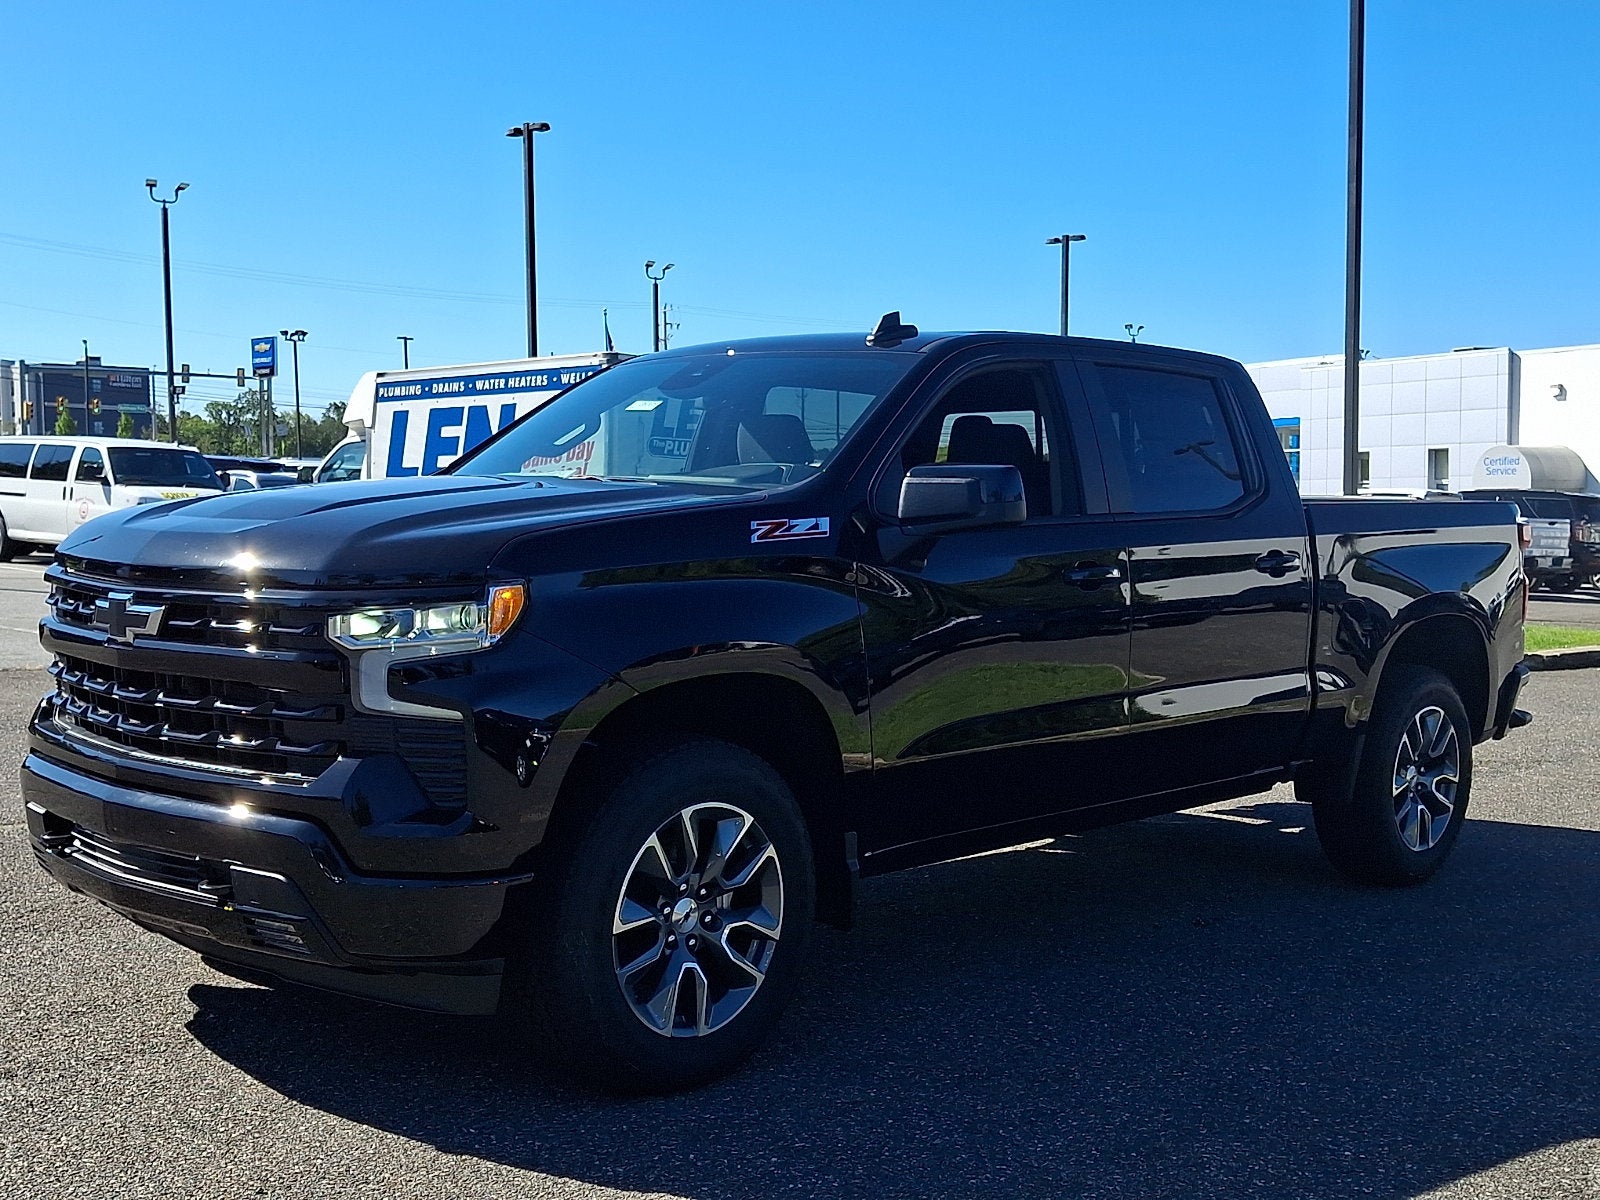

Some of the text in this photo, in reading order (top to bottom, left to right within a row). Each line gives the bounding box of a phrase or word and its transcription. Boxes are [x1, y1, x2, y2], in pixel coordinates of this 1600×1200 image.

[379, 385, 422, 398] PLUMBING
[432, 381, 465, 394] DRAINS
[475, 378, 504, 391] WATER
[508, 375, 548, 388] HEATERS
[1483, 456, 1519, 466] Certified
[1486, 467, 1517, 476] Service
[751, 517, 829, 543] Z71
